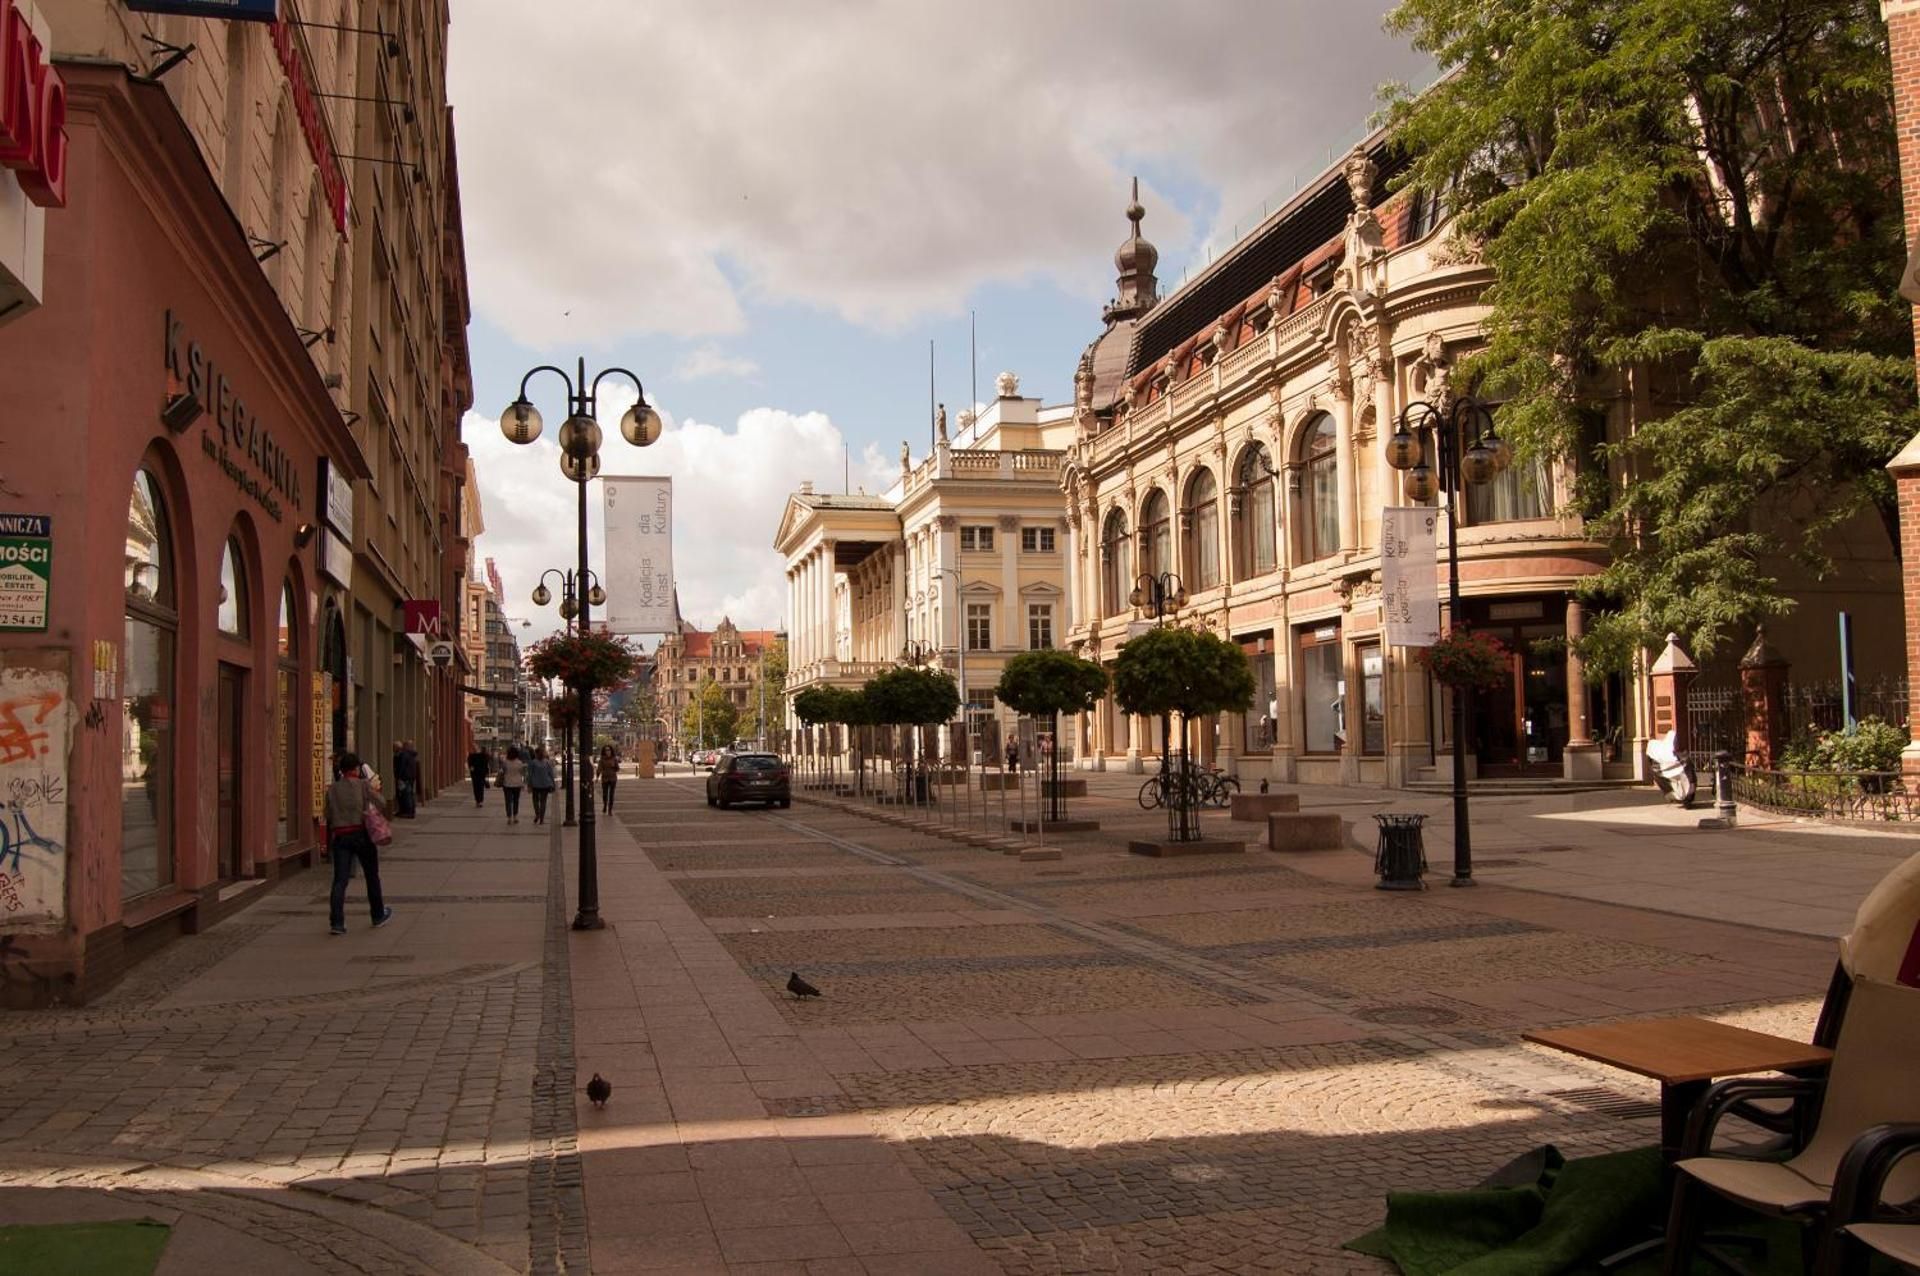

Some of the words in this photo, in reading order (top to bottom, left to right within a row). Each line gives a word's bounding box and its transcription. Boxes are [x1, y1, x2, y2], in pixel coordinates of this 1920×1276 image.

[164, 308, 300, 511] KSIĘGARNIA
[639, 513, 651, 535] dla
[655, 488, 670, 534] Kultury
[641, 558, 655, 608] Koalicja
[656, 573, 669, 608] Miast
